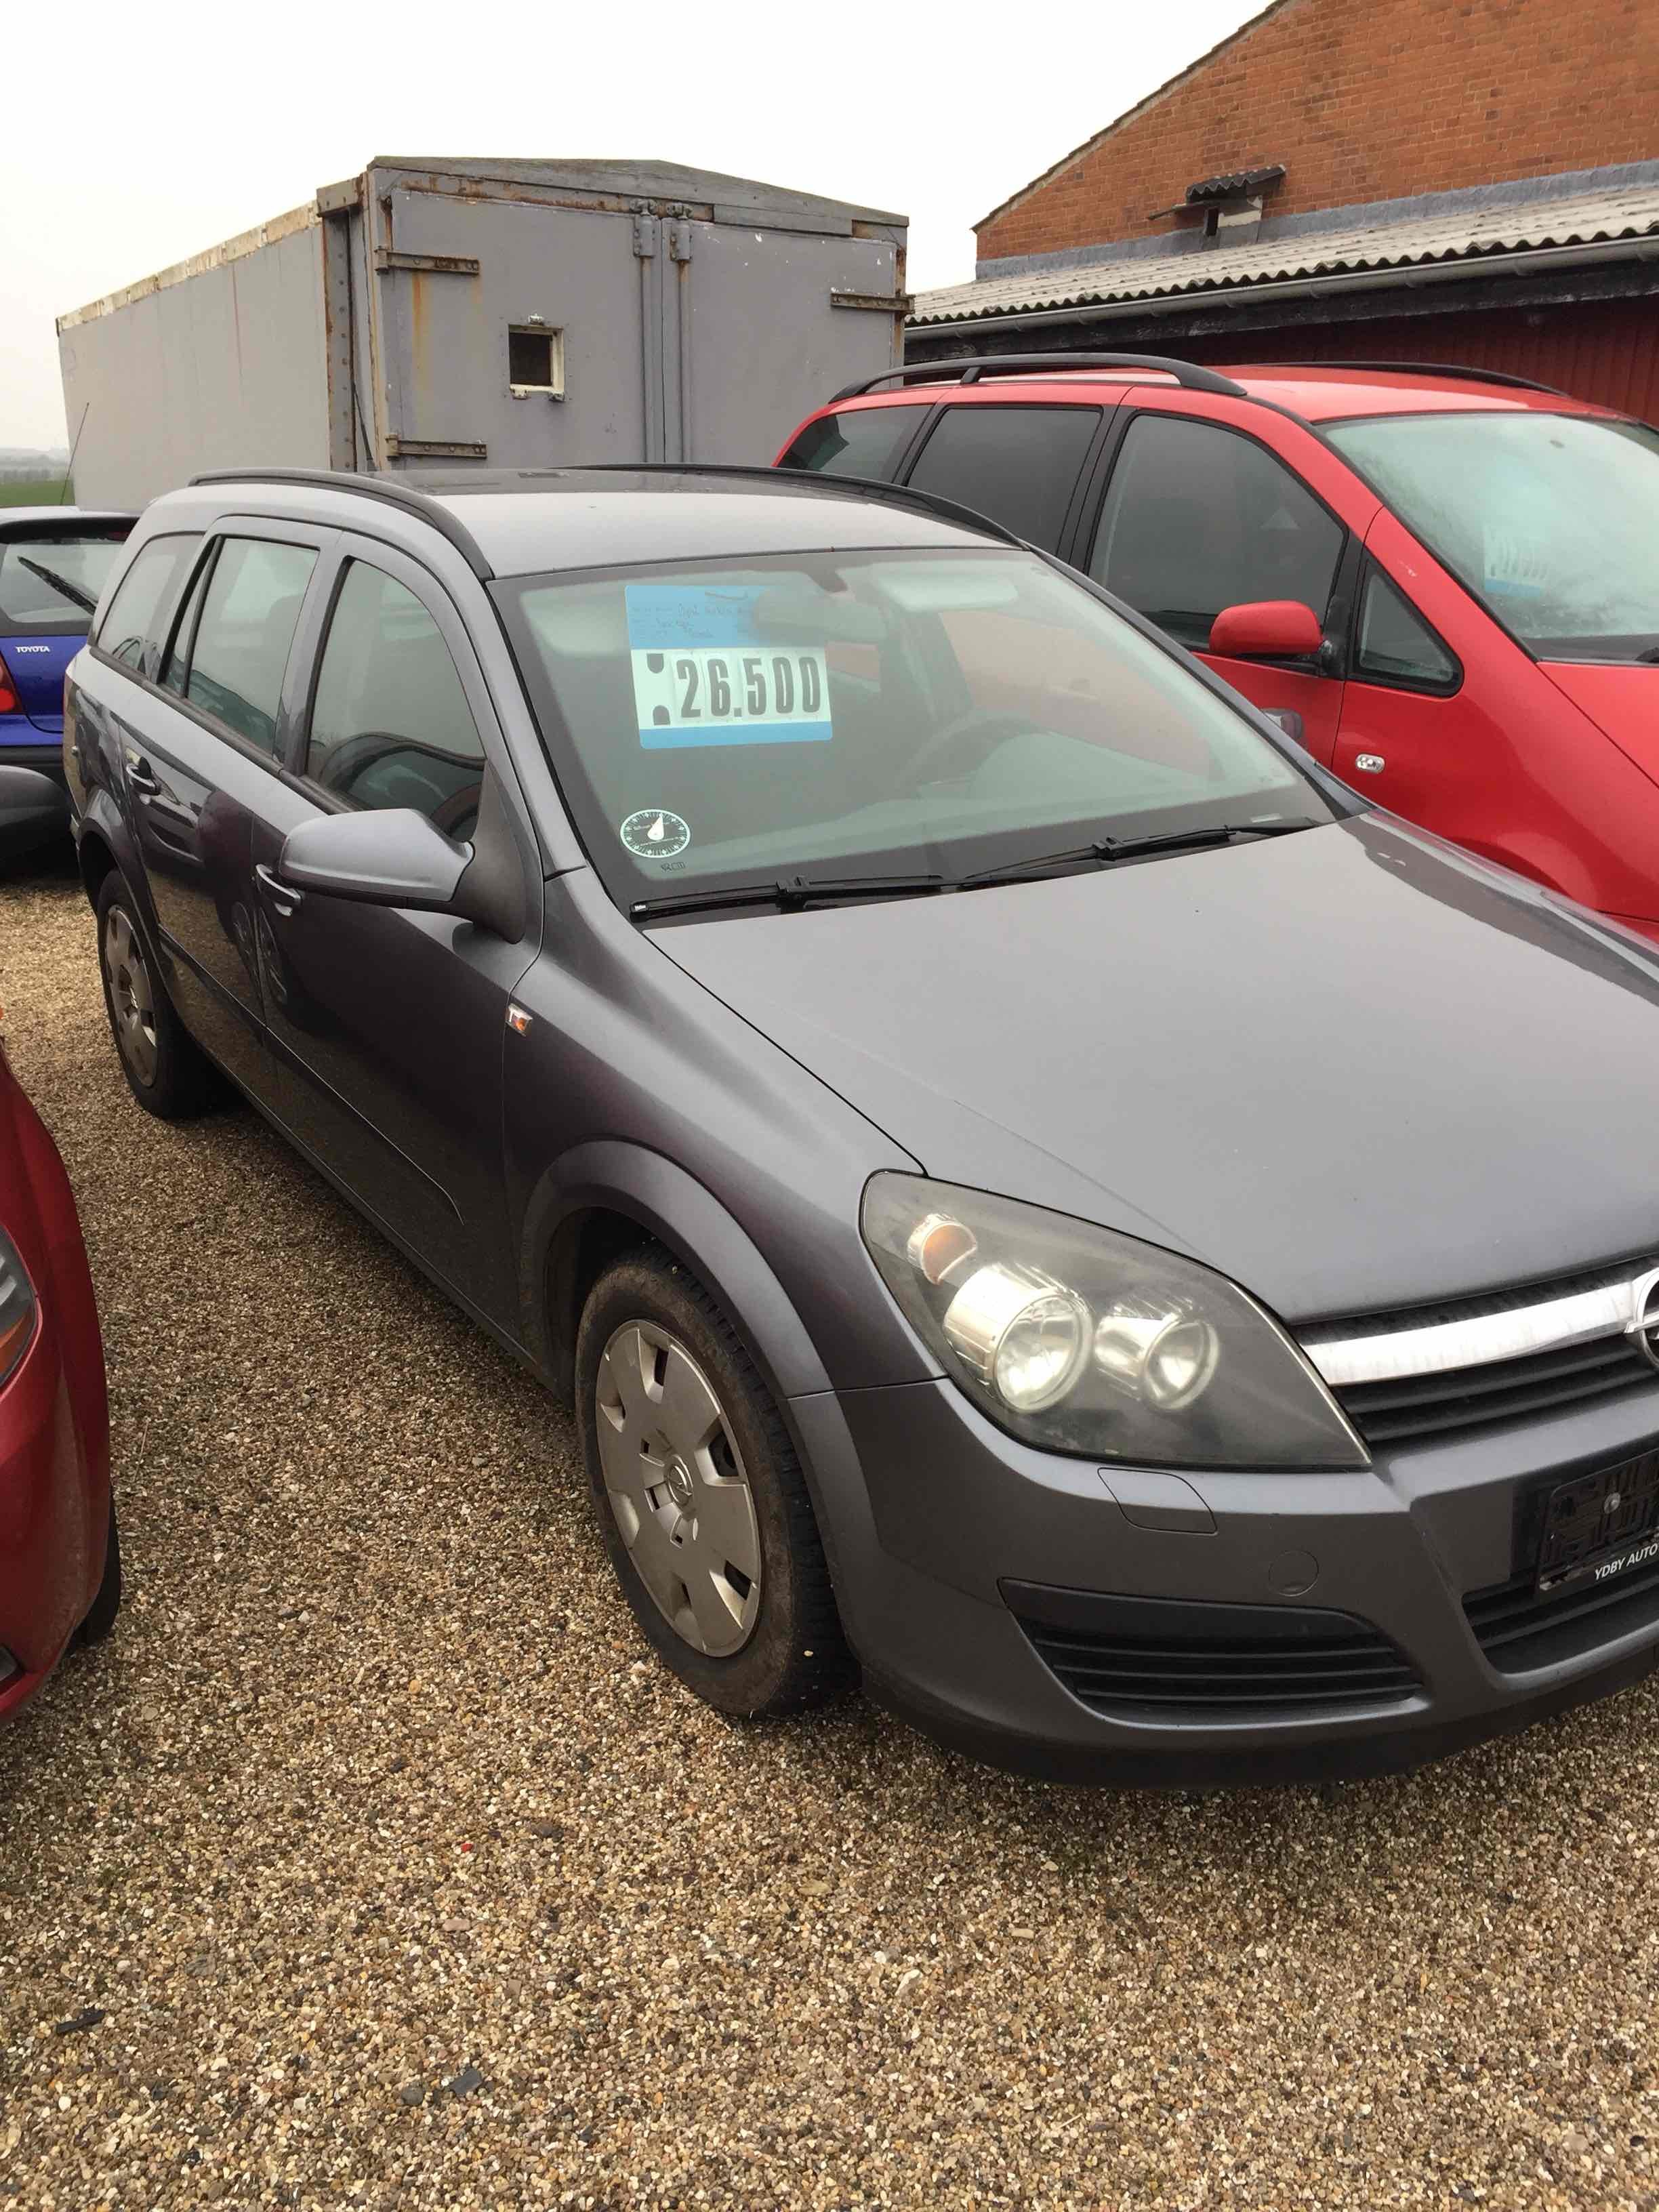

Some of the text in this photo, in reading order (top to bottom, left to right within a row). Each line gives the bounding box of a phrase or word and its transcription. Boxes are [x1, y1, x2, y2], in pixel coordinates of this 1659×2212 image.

[16, 645, 50, 653] TOYOTA
[676, 657, 821, 718] 26.500
[1595, 1557, 1626, 1580] YDBY
